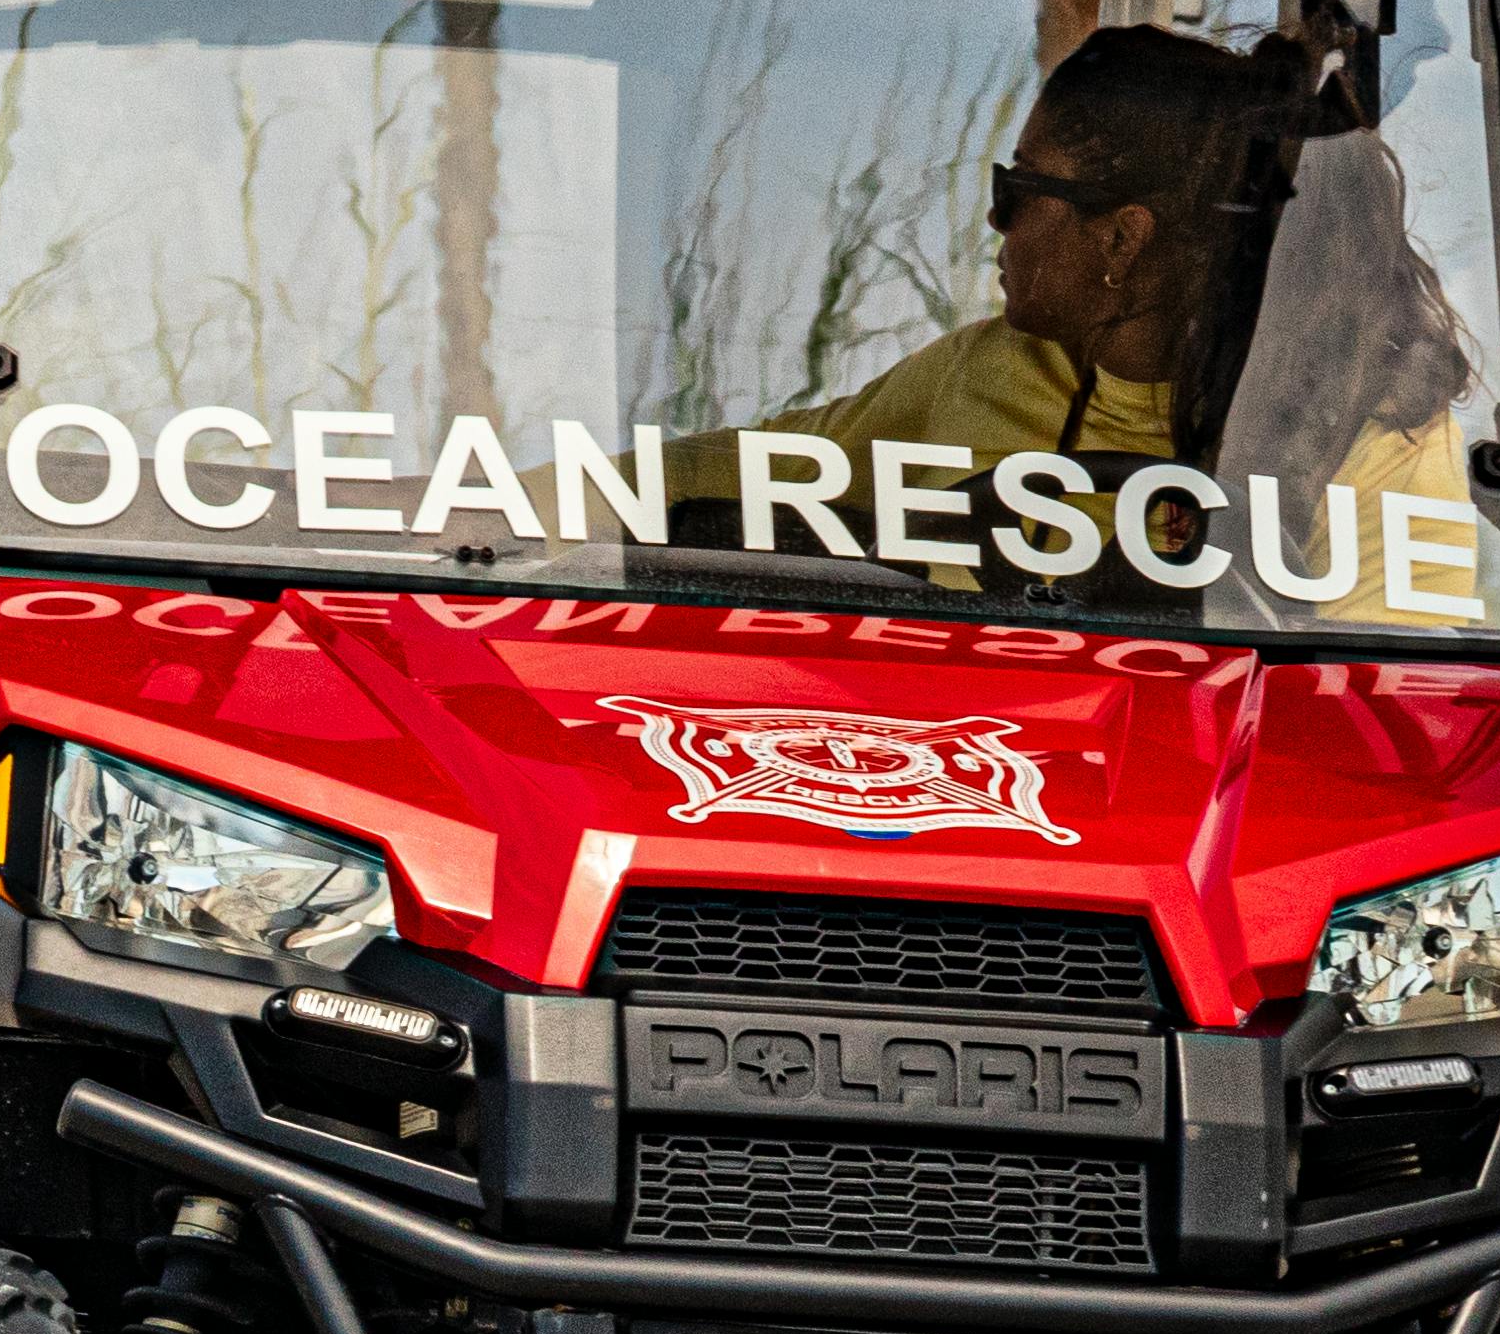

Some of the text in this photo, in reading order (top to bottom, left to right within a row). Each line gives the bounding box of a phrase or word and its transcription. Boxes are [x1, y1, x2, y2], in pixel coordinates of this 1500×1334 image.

[4, 403, 1485, 619] OCEAN RESCUE
[750, 720, 892, 734] OCEAN
[763, 758, 935, 784] AMELIA ISLAND
[783, 784, 943, 807] RESCUE
[650, 1023, 1143, 1117] POLARIS
